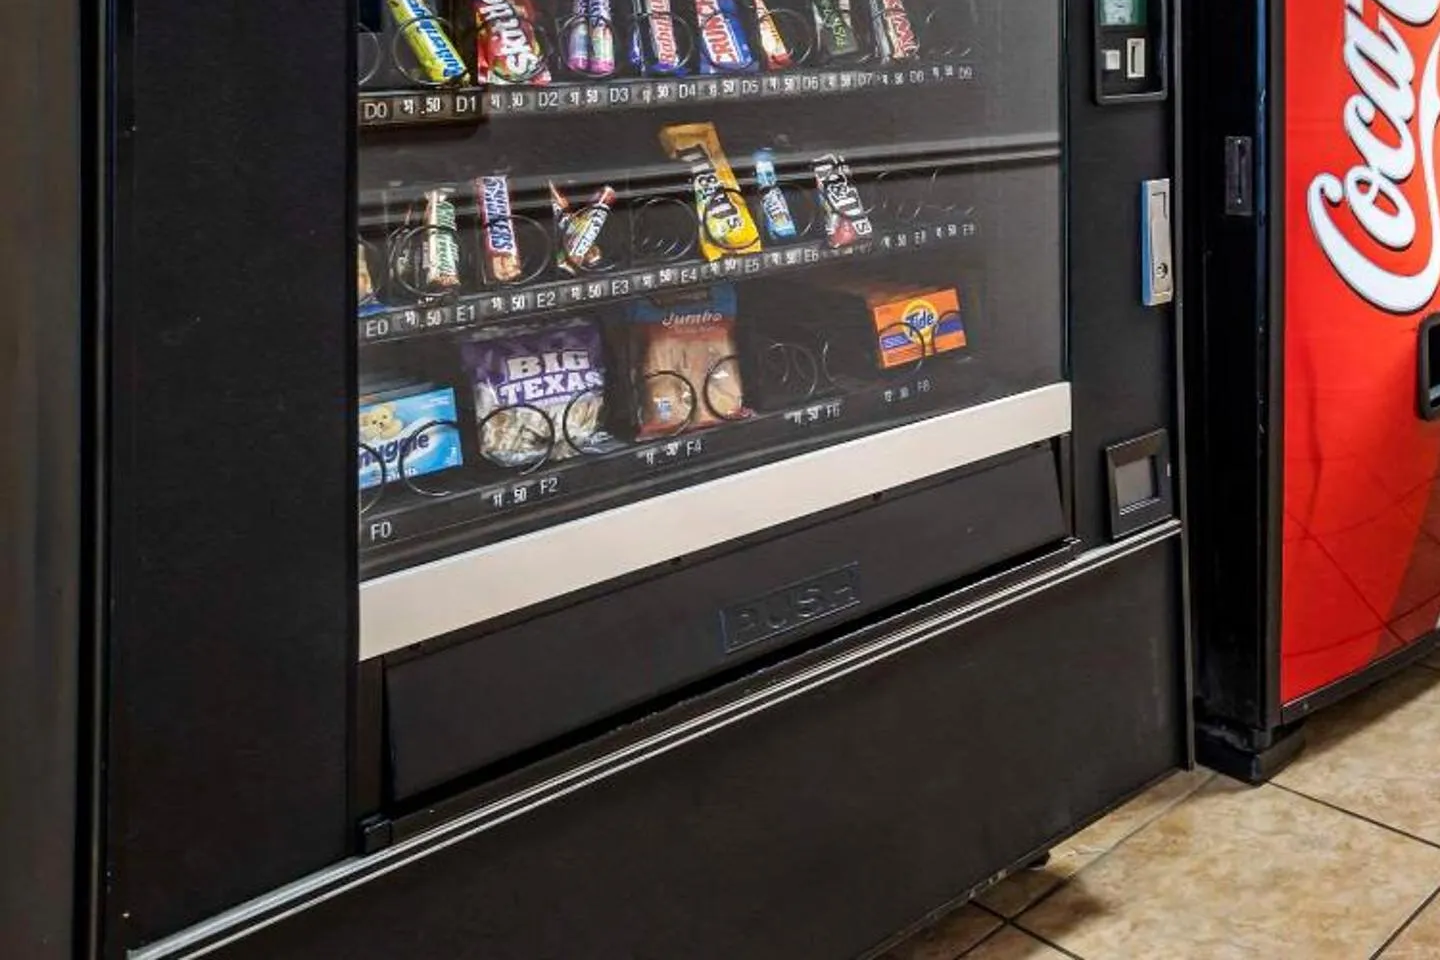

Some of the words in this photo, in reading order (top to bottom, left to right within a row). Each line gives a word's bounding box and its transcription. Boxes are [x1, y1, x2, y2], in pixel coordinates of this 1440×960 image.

[538, 91, 559, 107] D2
[610, 87, 629, 103] D3
[679, 83, 696, 99] D4
[364, 102, 387, 120] D0
[456, 95, 476, 113] D1
[681, 267, 697, 284] E4
[611, 279, 629, 296] E3
[537, 291, 557, 308] E2
[456, 305, 475, 323] E1
[366, 320, 389, 338] E0
[904, 309, 936, 340] Tide
[506, 350, 591, 381] BIG
[498, 371, 603, 404] TEXAS
[359, 433, 430, 468] nuggle
[686, 442, 702, 459] F4
[539, 477, 558, 496] F2
[370, 521, 392, 542] F0
